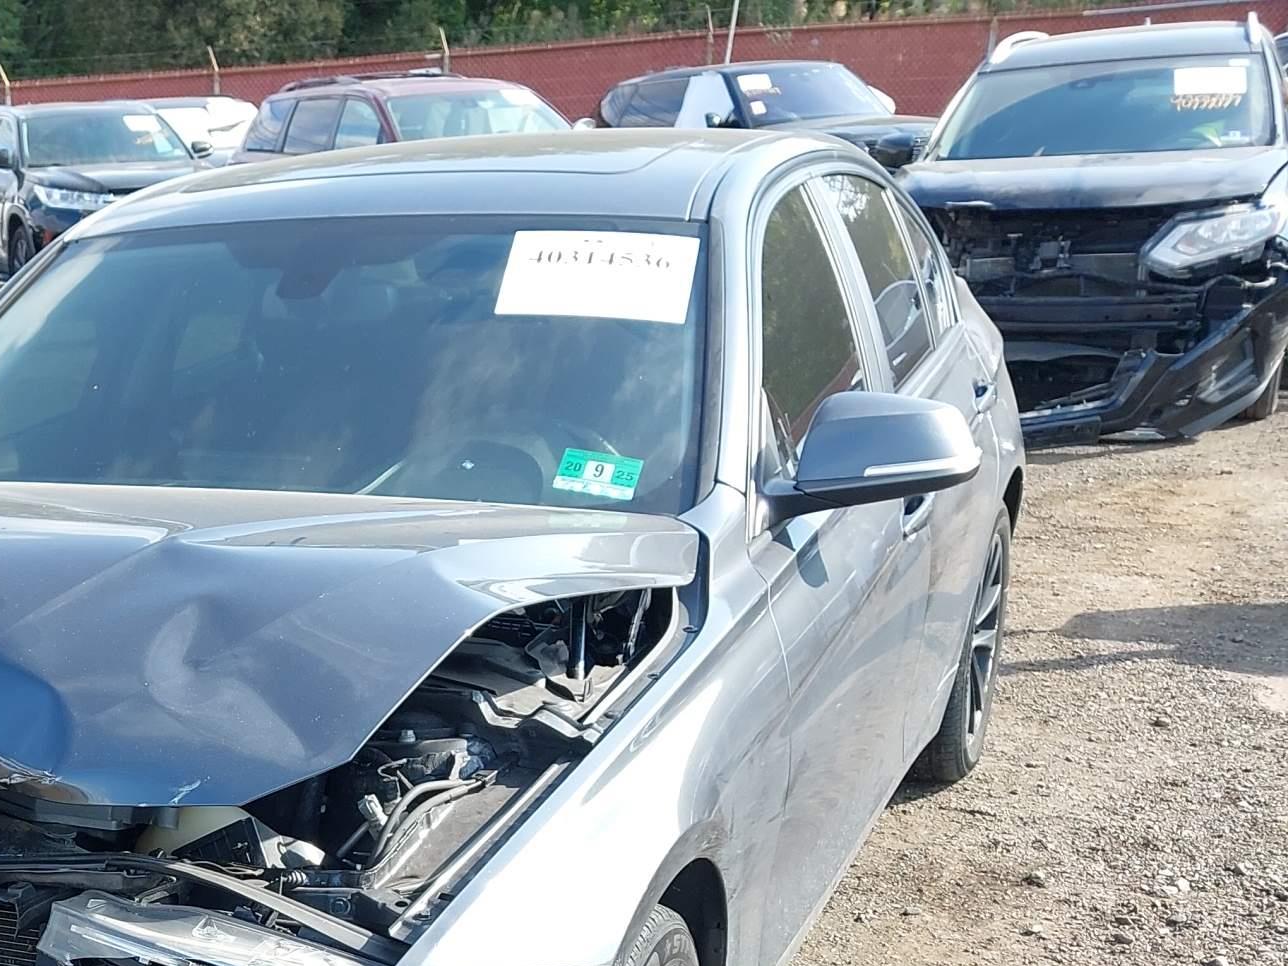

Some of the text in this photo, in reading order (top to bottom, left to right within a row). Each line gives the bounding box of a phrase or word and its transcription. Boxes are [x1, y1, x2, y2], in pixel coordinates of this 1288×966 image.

[564, 460, 634, 481] 20 9 25
